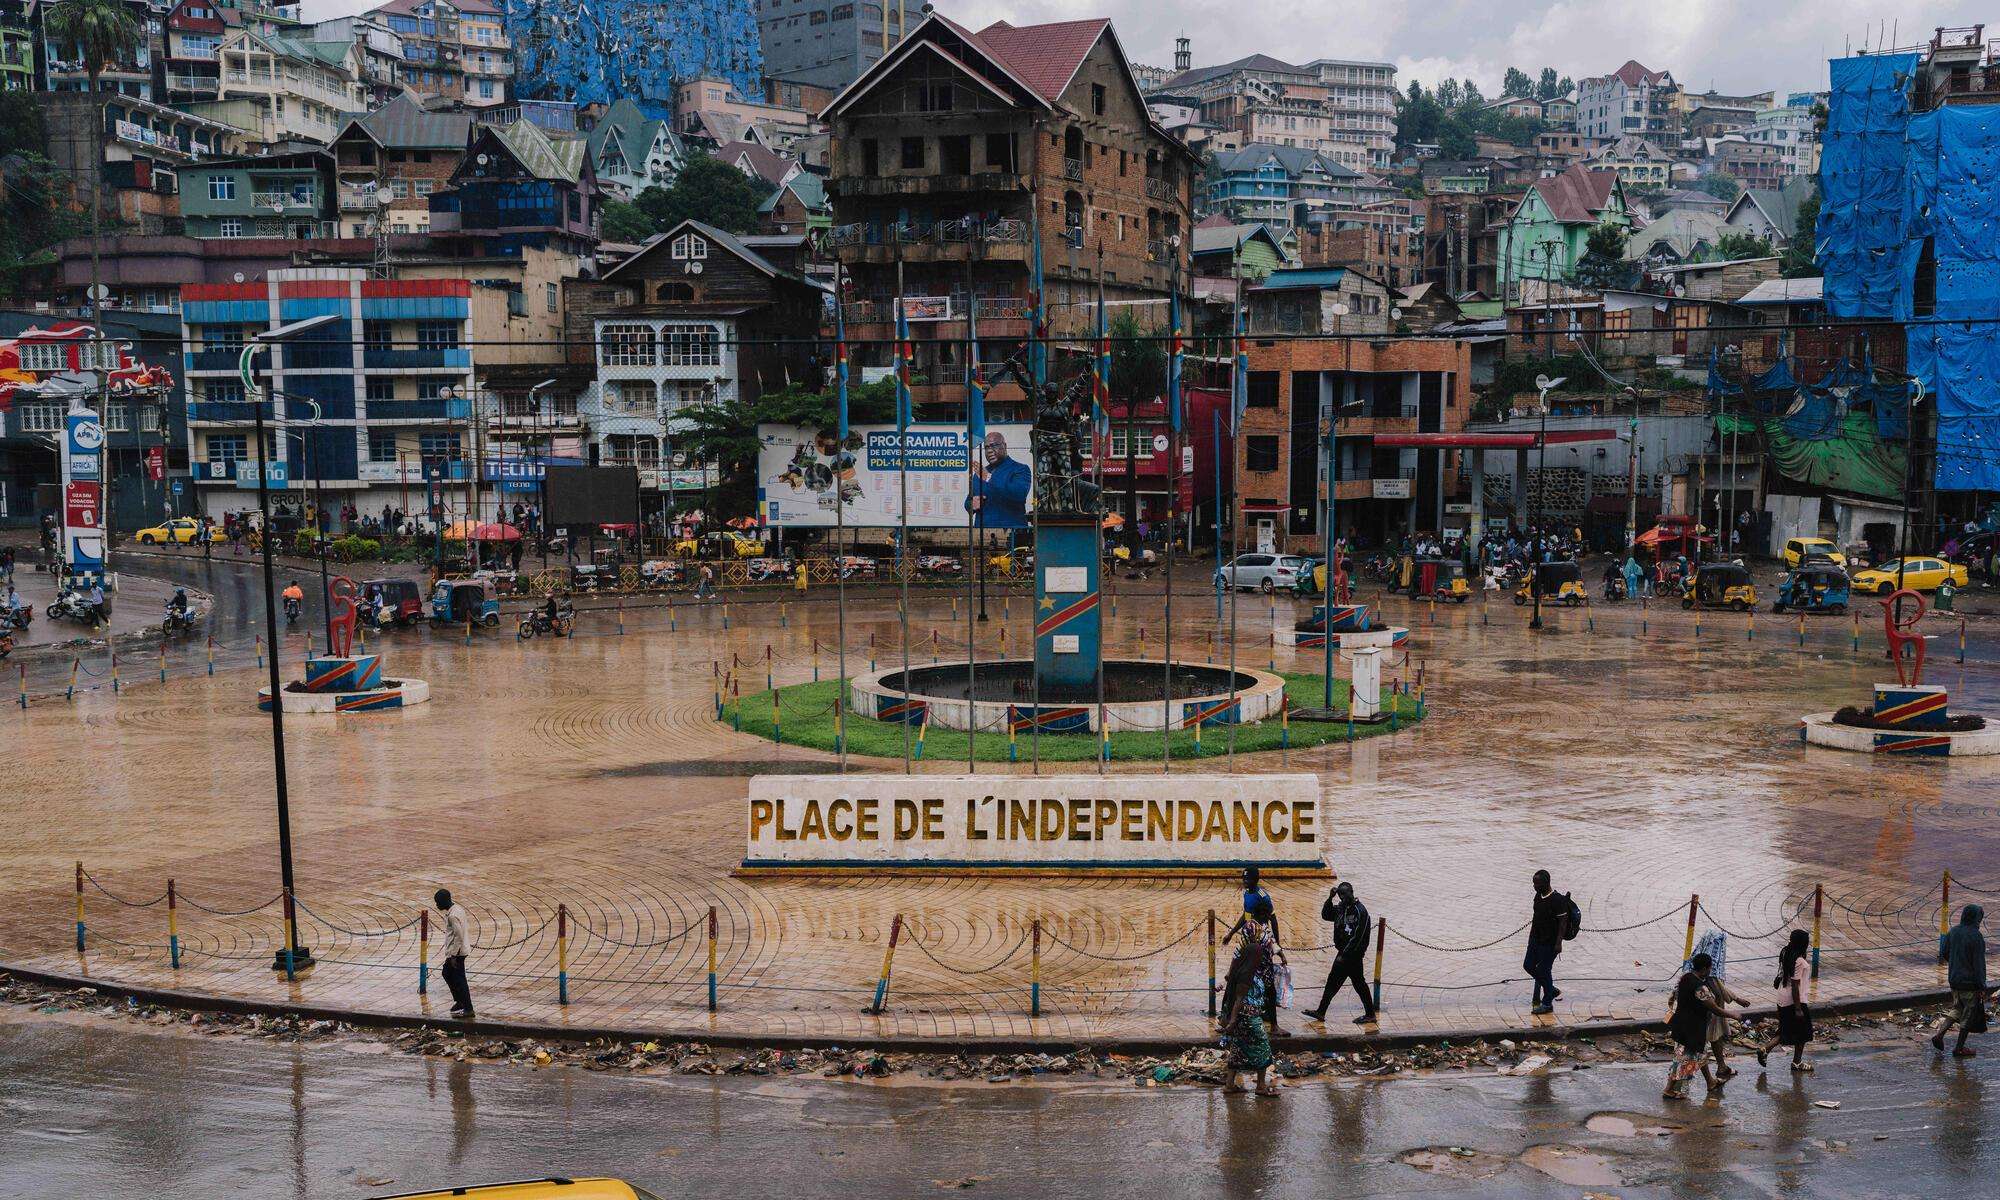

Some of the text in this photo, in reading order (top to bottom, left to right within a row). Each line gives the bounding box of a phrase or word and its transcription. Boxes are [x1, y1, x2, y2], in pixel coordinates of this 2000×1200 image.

[486, 462, 546, 476] TECNO
[870, 458, 966, 467] PDL-14 TERRITOIRES
[750, 799, 879, 842] PLACE
[893, 799, 946, 841] DE
